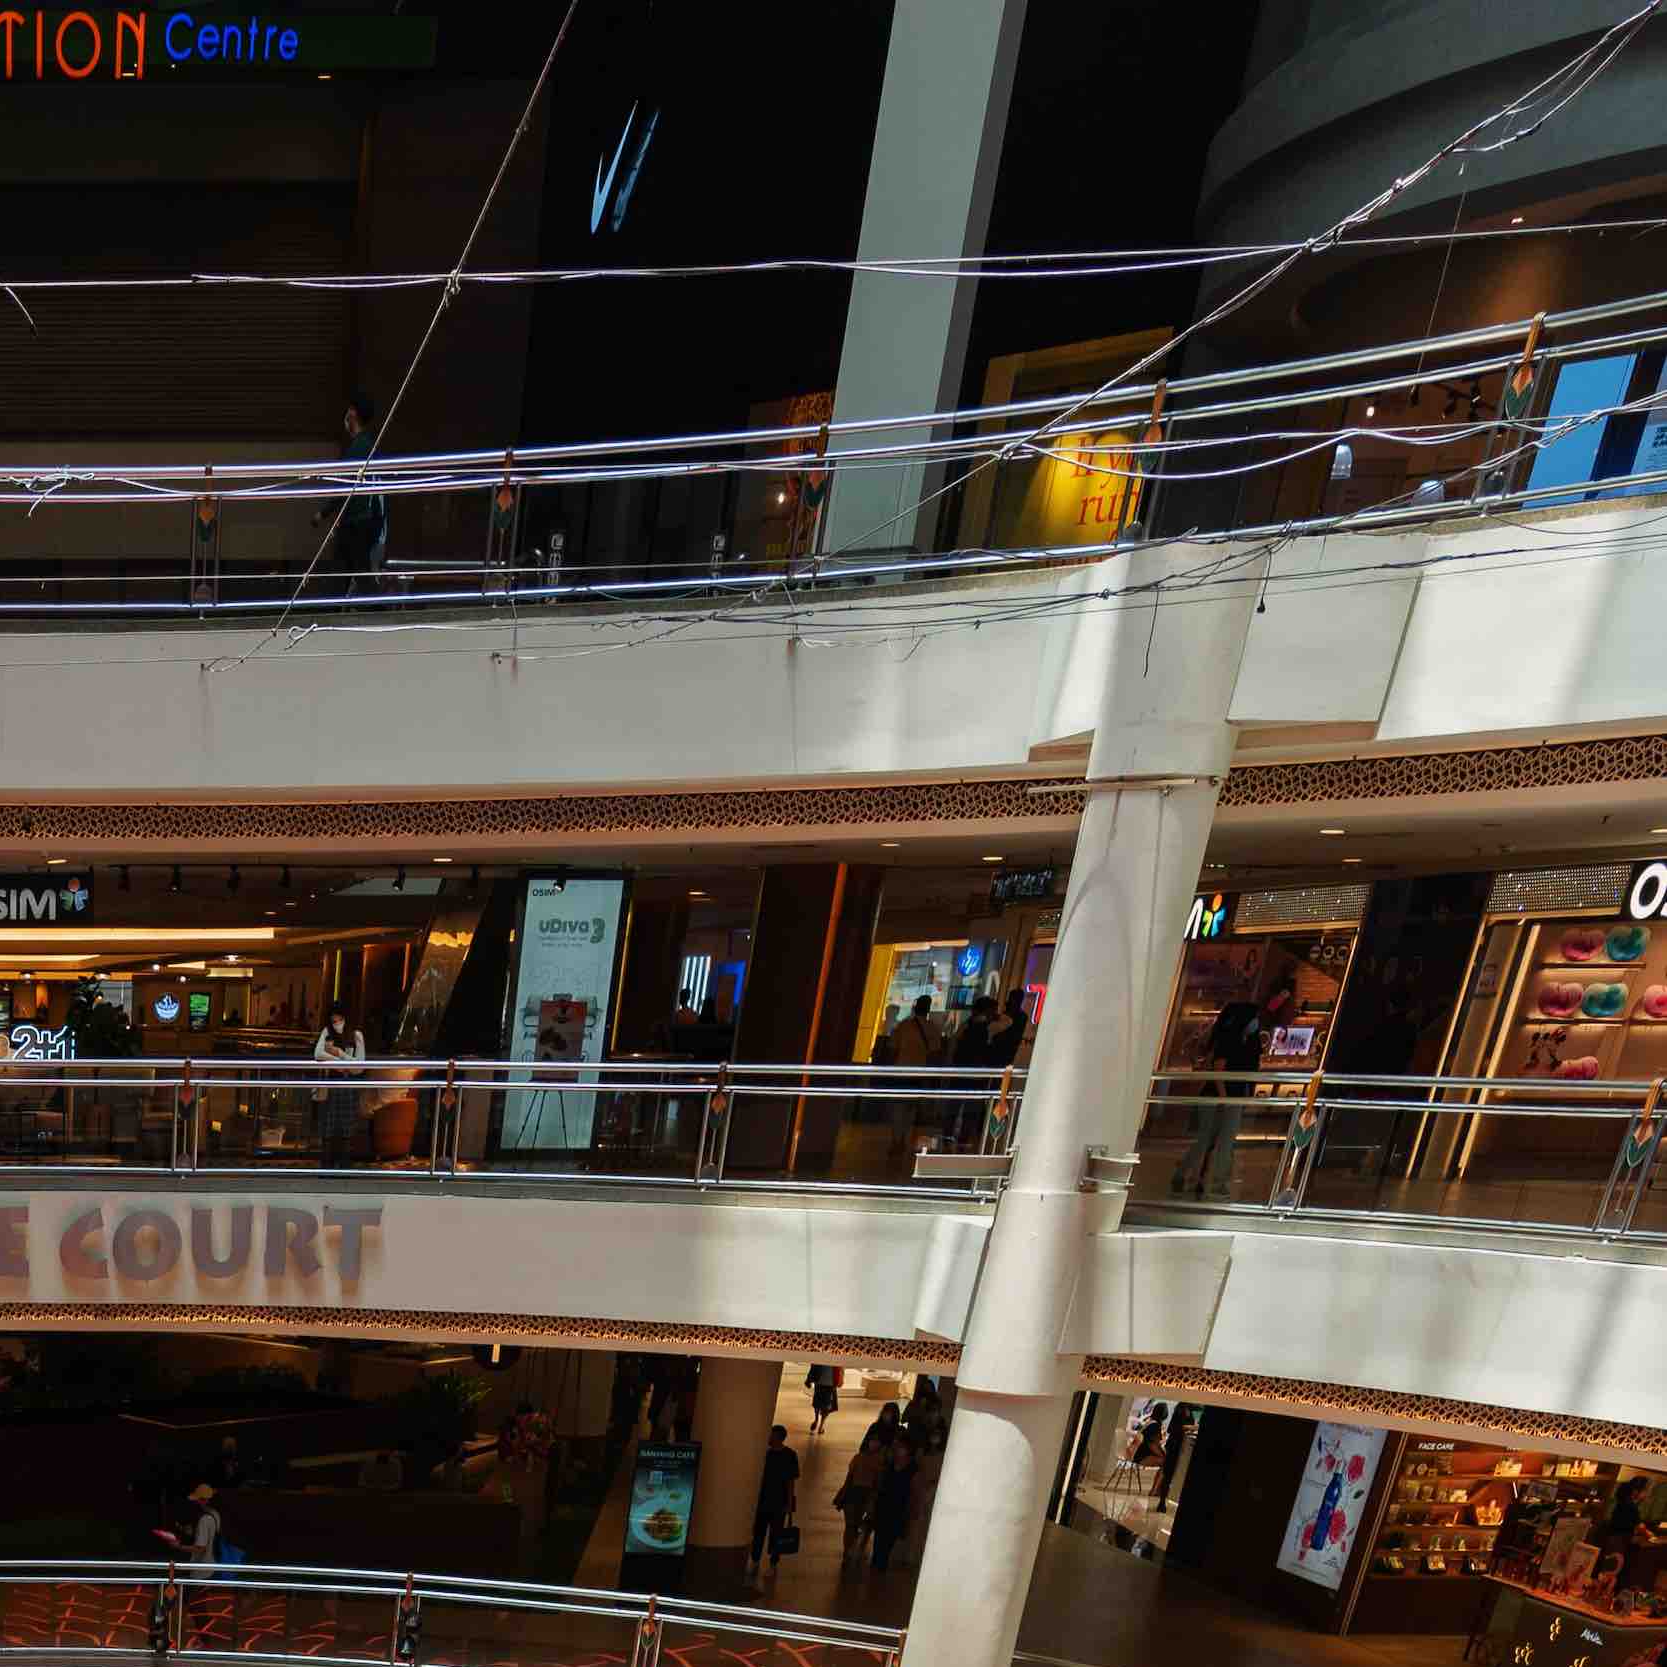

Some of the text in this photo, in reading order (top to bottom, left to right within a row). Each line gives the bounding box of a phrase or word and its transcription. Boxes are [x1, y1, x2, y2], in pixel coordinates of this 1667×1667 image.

[165, 13, 300, 63] Centre
[532, 888, 556, 898] OSIM
[59, 1205, 382, 1281] COURT
[1418, 1442, 1455, 1451] FACE CARE
